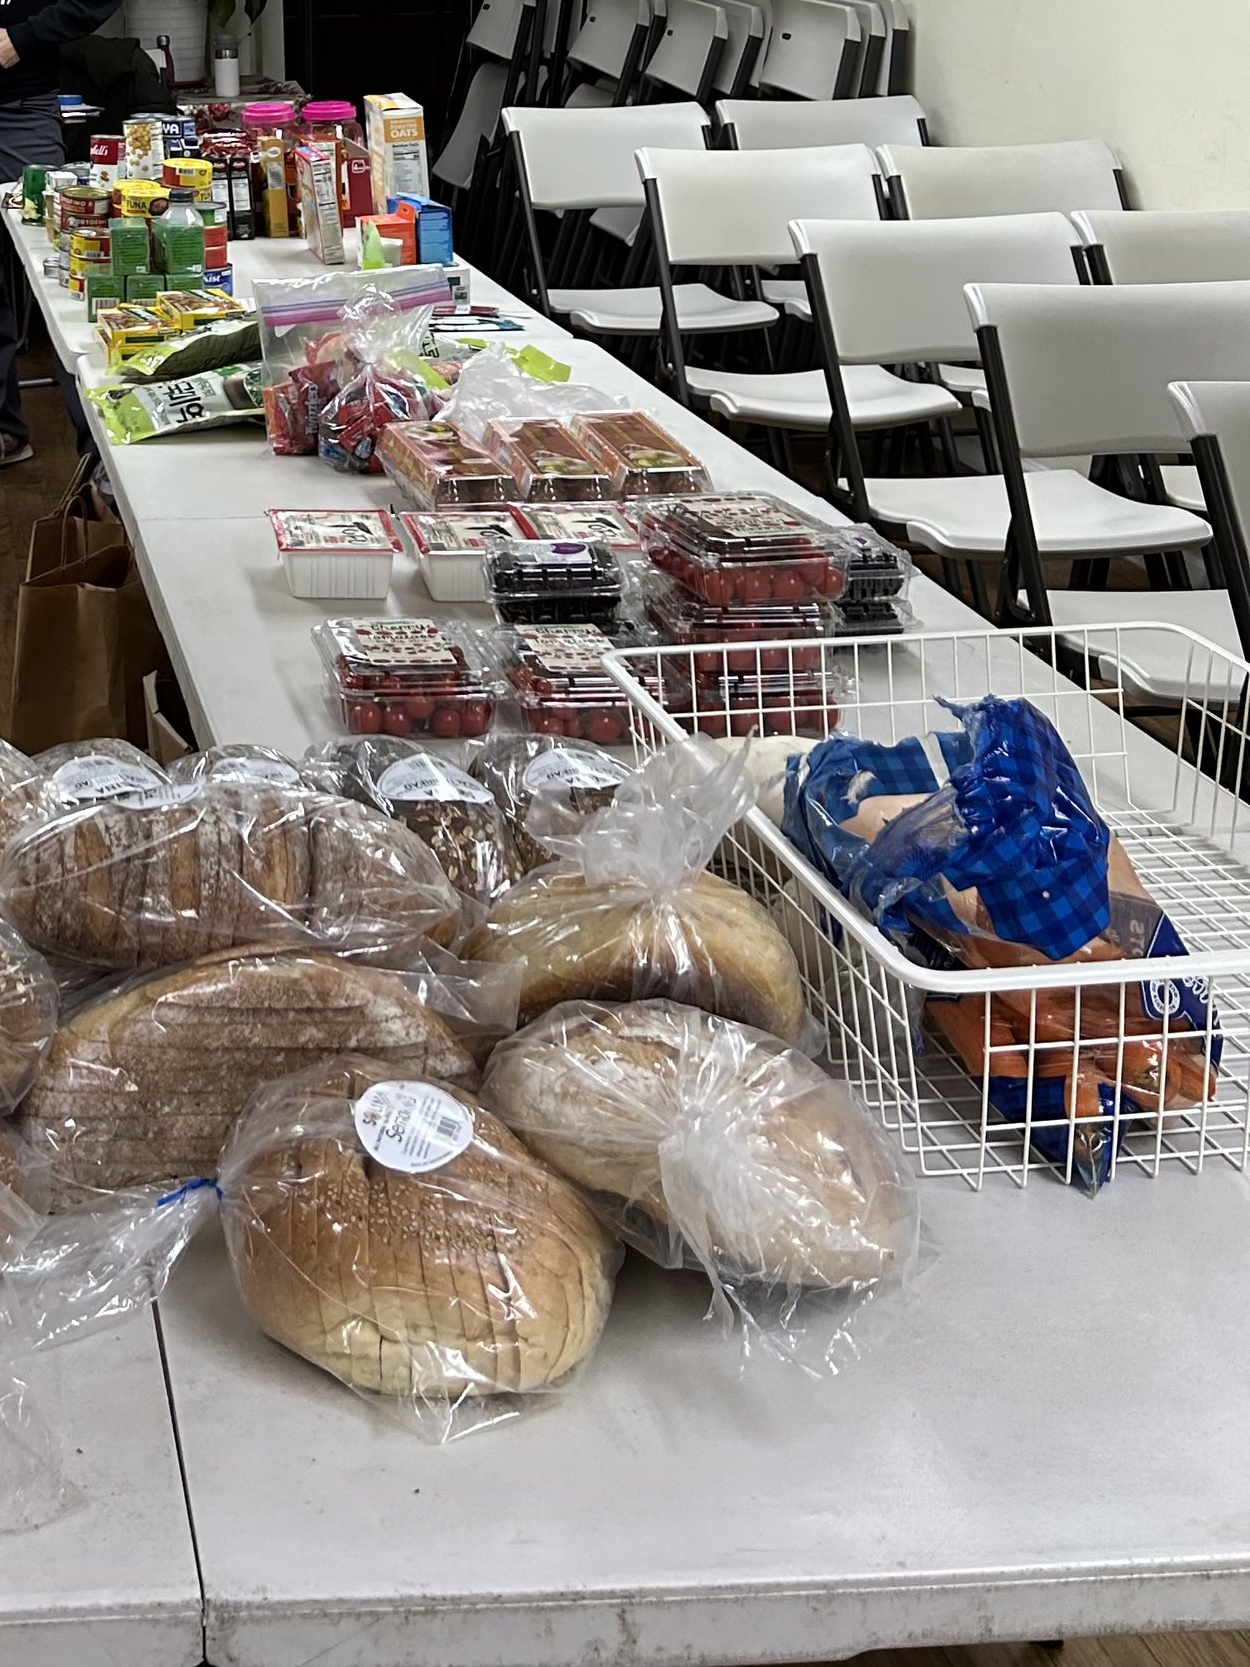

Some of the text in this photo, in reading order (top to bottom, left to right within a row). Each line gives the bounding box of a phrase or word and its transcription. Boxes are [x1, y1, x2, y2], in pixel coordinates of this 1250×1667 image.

[162, 123, 180, 134] YA
[390, 128, 418, 138] OATS
[126, 199, 147, 210] TUNA
